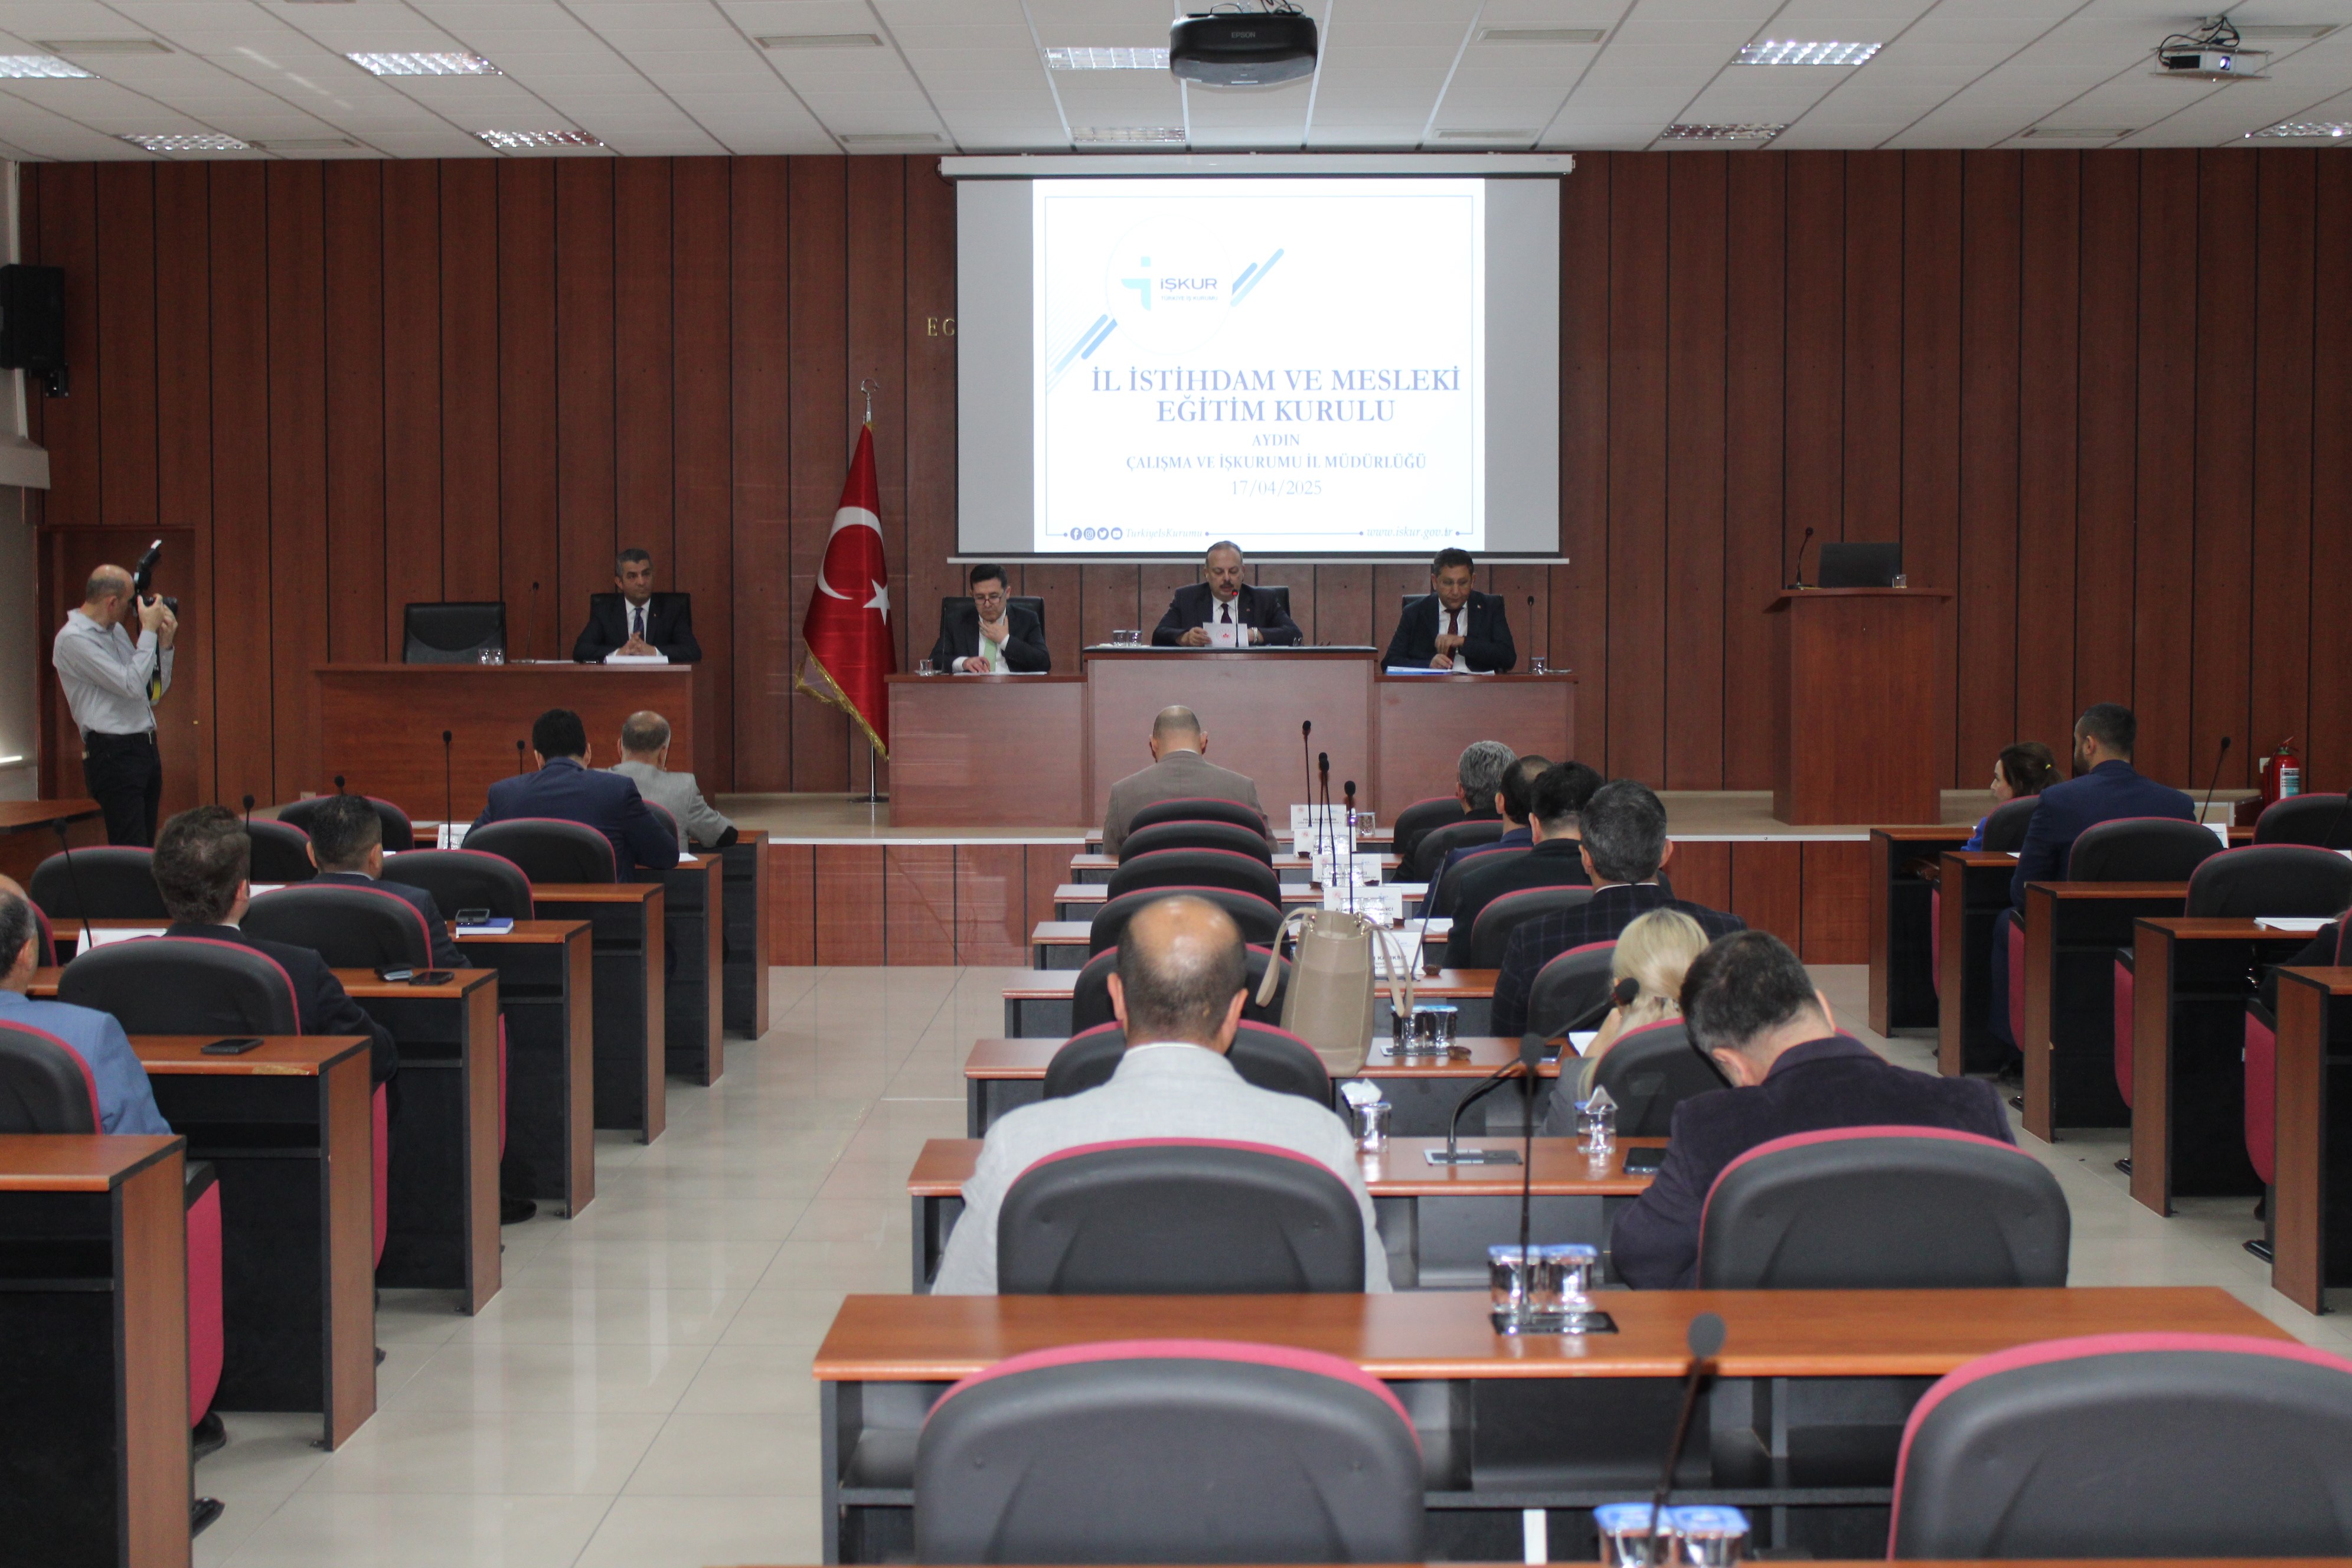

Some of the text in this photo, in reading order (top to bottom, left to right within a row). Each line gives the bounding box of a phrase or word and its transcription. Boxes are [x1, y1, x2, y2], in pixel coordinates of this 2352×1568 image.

[1092, 365, 1460, 391] İL İSTİHDAM VE MESLEKİ
[1157, 395, 1395, 422] EĞİTİM KURULU
[1253, 435, 1299, 446] AYDIN
[1126, 453, 1426, 472] ÇALIŞMA VE İŞKURUMU İL MÜDÜRLÜĞÜ
[1233, 479, 1322, 496] 17/04/2025
